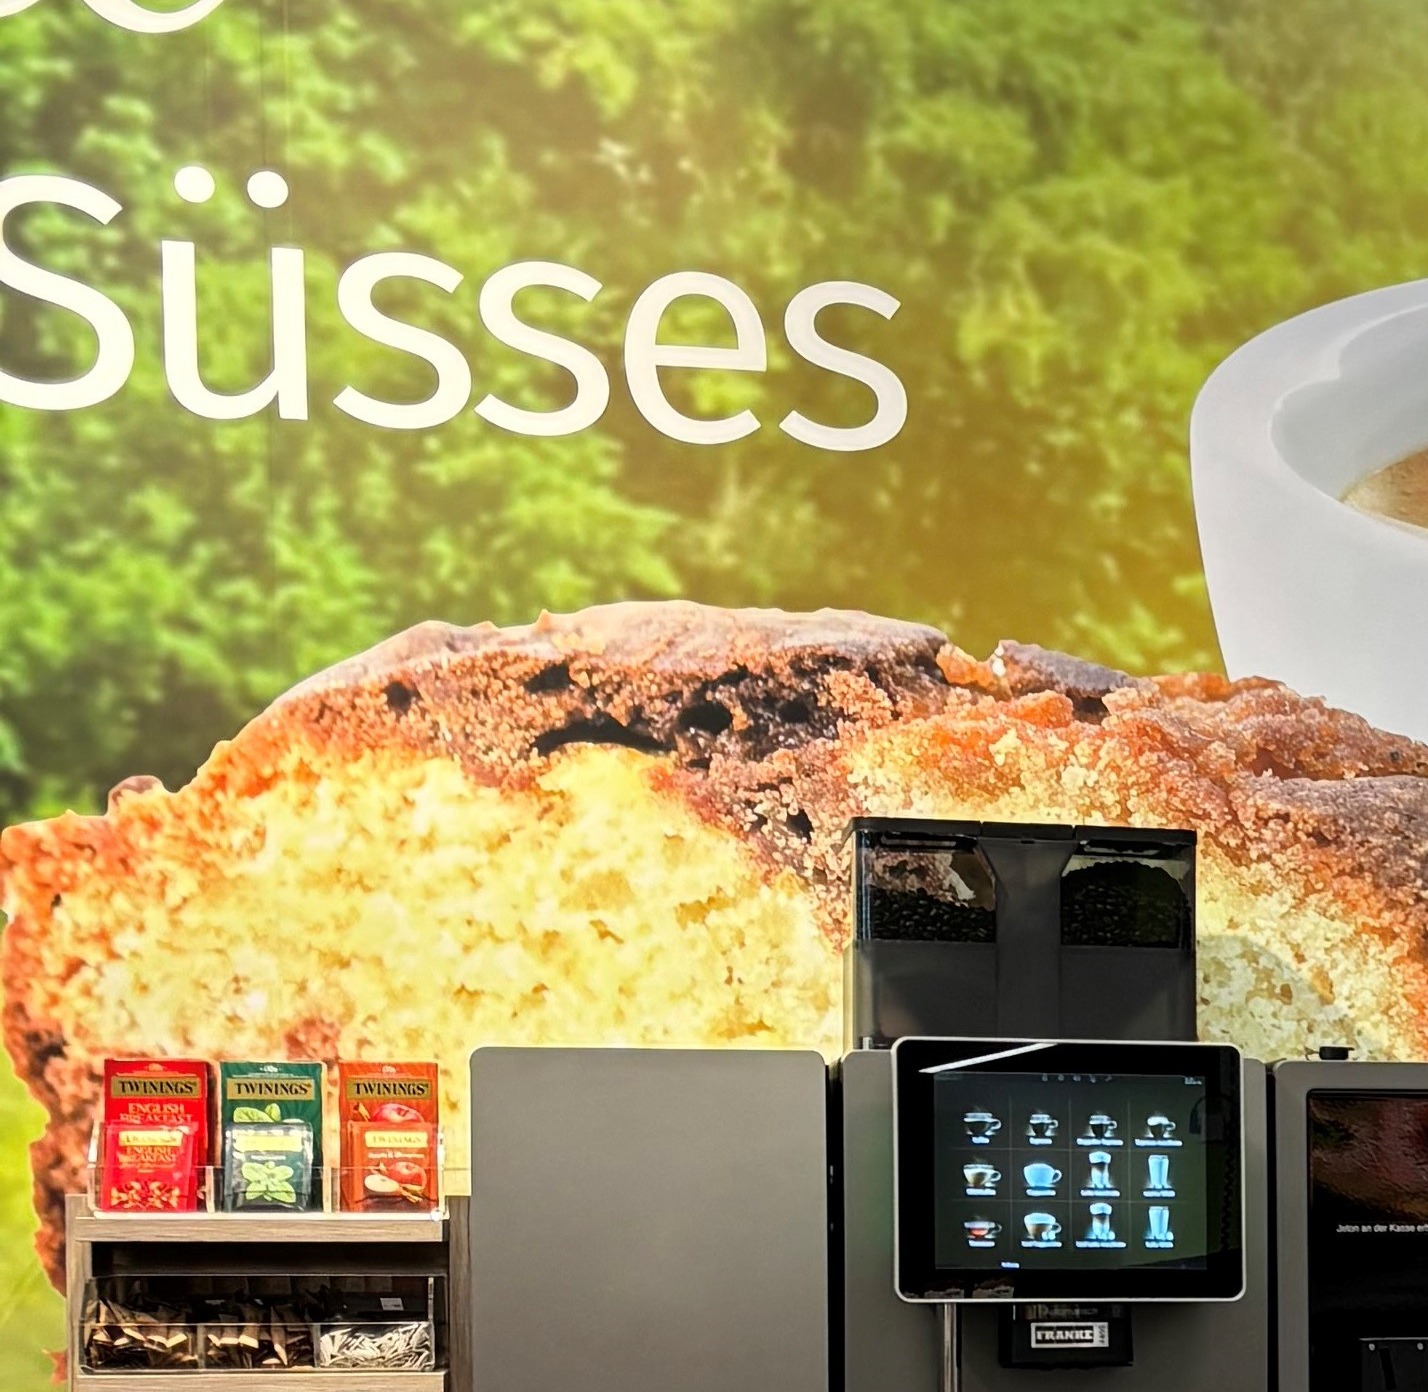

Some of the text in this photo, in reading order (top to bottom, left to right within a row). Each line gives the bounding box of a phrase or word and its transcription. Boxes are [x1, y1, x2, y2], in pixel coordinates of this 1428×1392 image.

[0, 166, 908, 452] Süsses
[119, 1081, 193, 1094] TWININGS
[236, 1082, 309, 1094] TWININGS
[356, 1082, 426, 1096] TWININGS
[128, 1103, 184, 1114] ENGLISH
[1037, 1330, 1093, 1340] FRANKE
